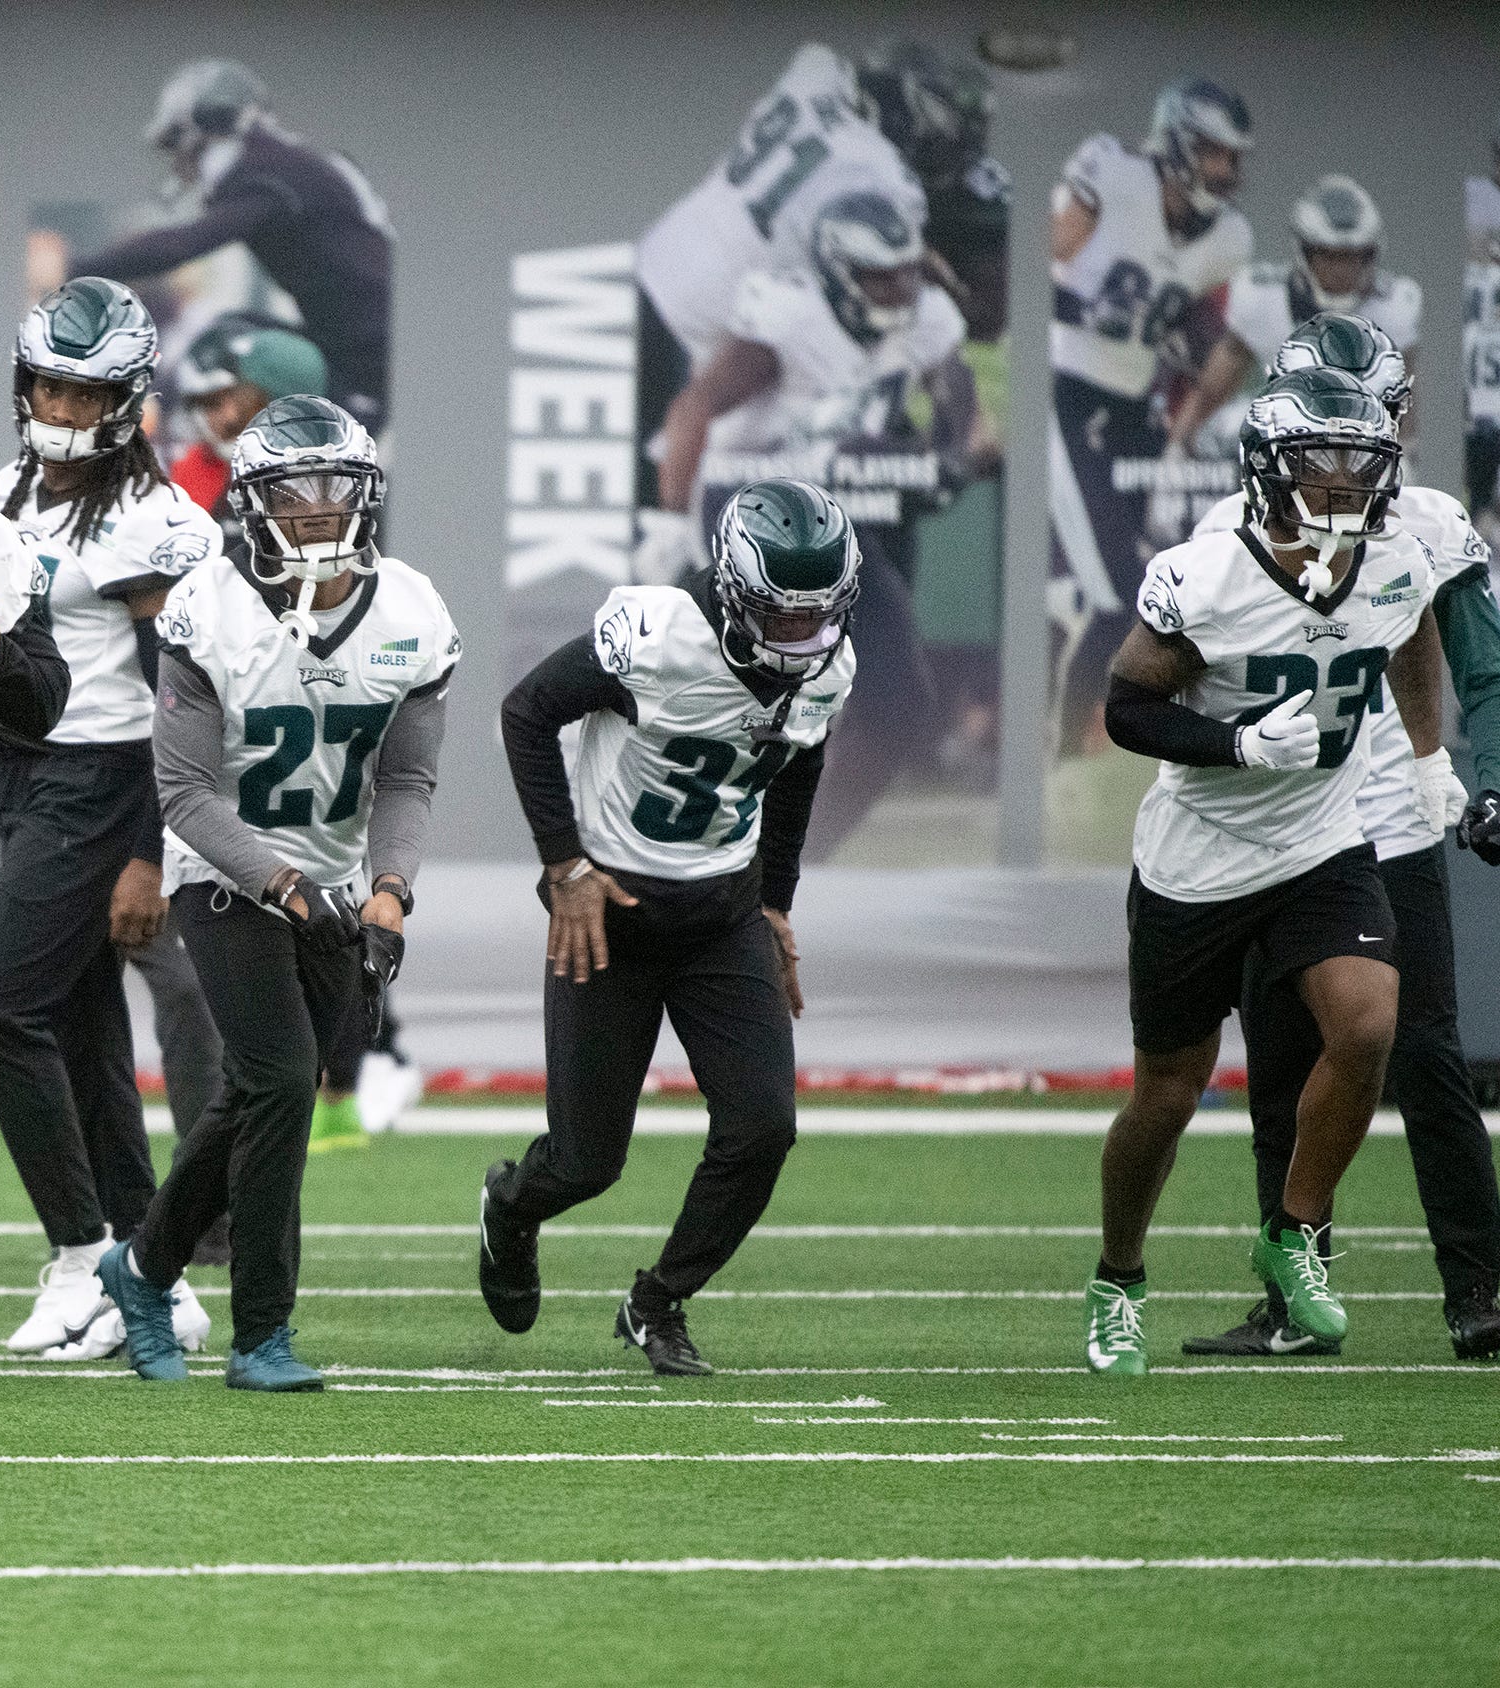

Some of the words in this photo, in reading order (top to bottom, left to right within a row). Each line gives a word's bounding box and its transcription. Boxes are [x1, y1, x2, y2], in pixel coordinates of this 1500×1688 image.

[506, 241, 638, 588] WEEK
[1370, 592, 1403, 608] EAGLES
[1303, 624, 1349, 643] EAGLES
[370, 653, 407, 666] EAGLES
[299, 667, 348, 687] EAGLES
[1232, 645, 1389, 769] 23
[237, 700, 396, 829] 27
